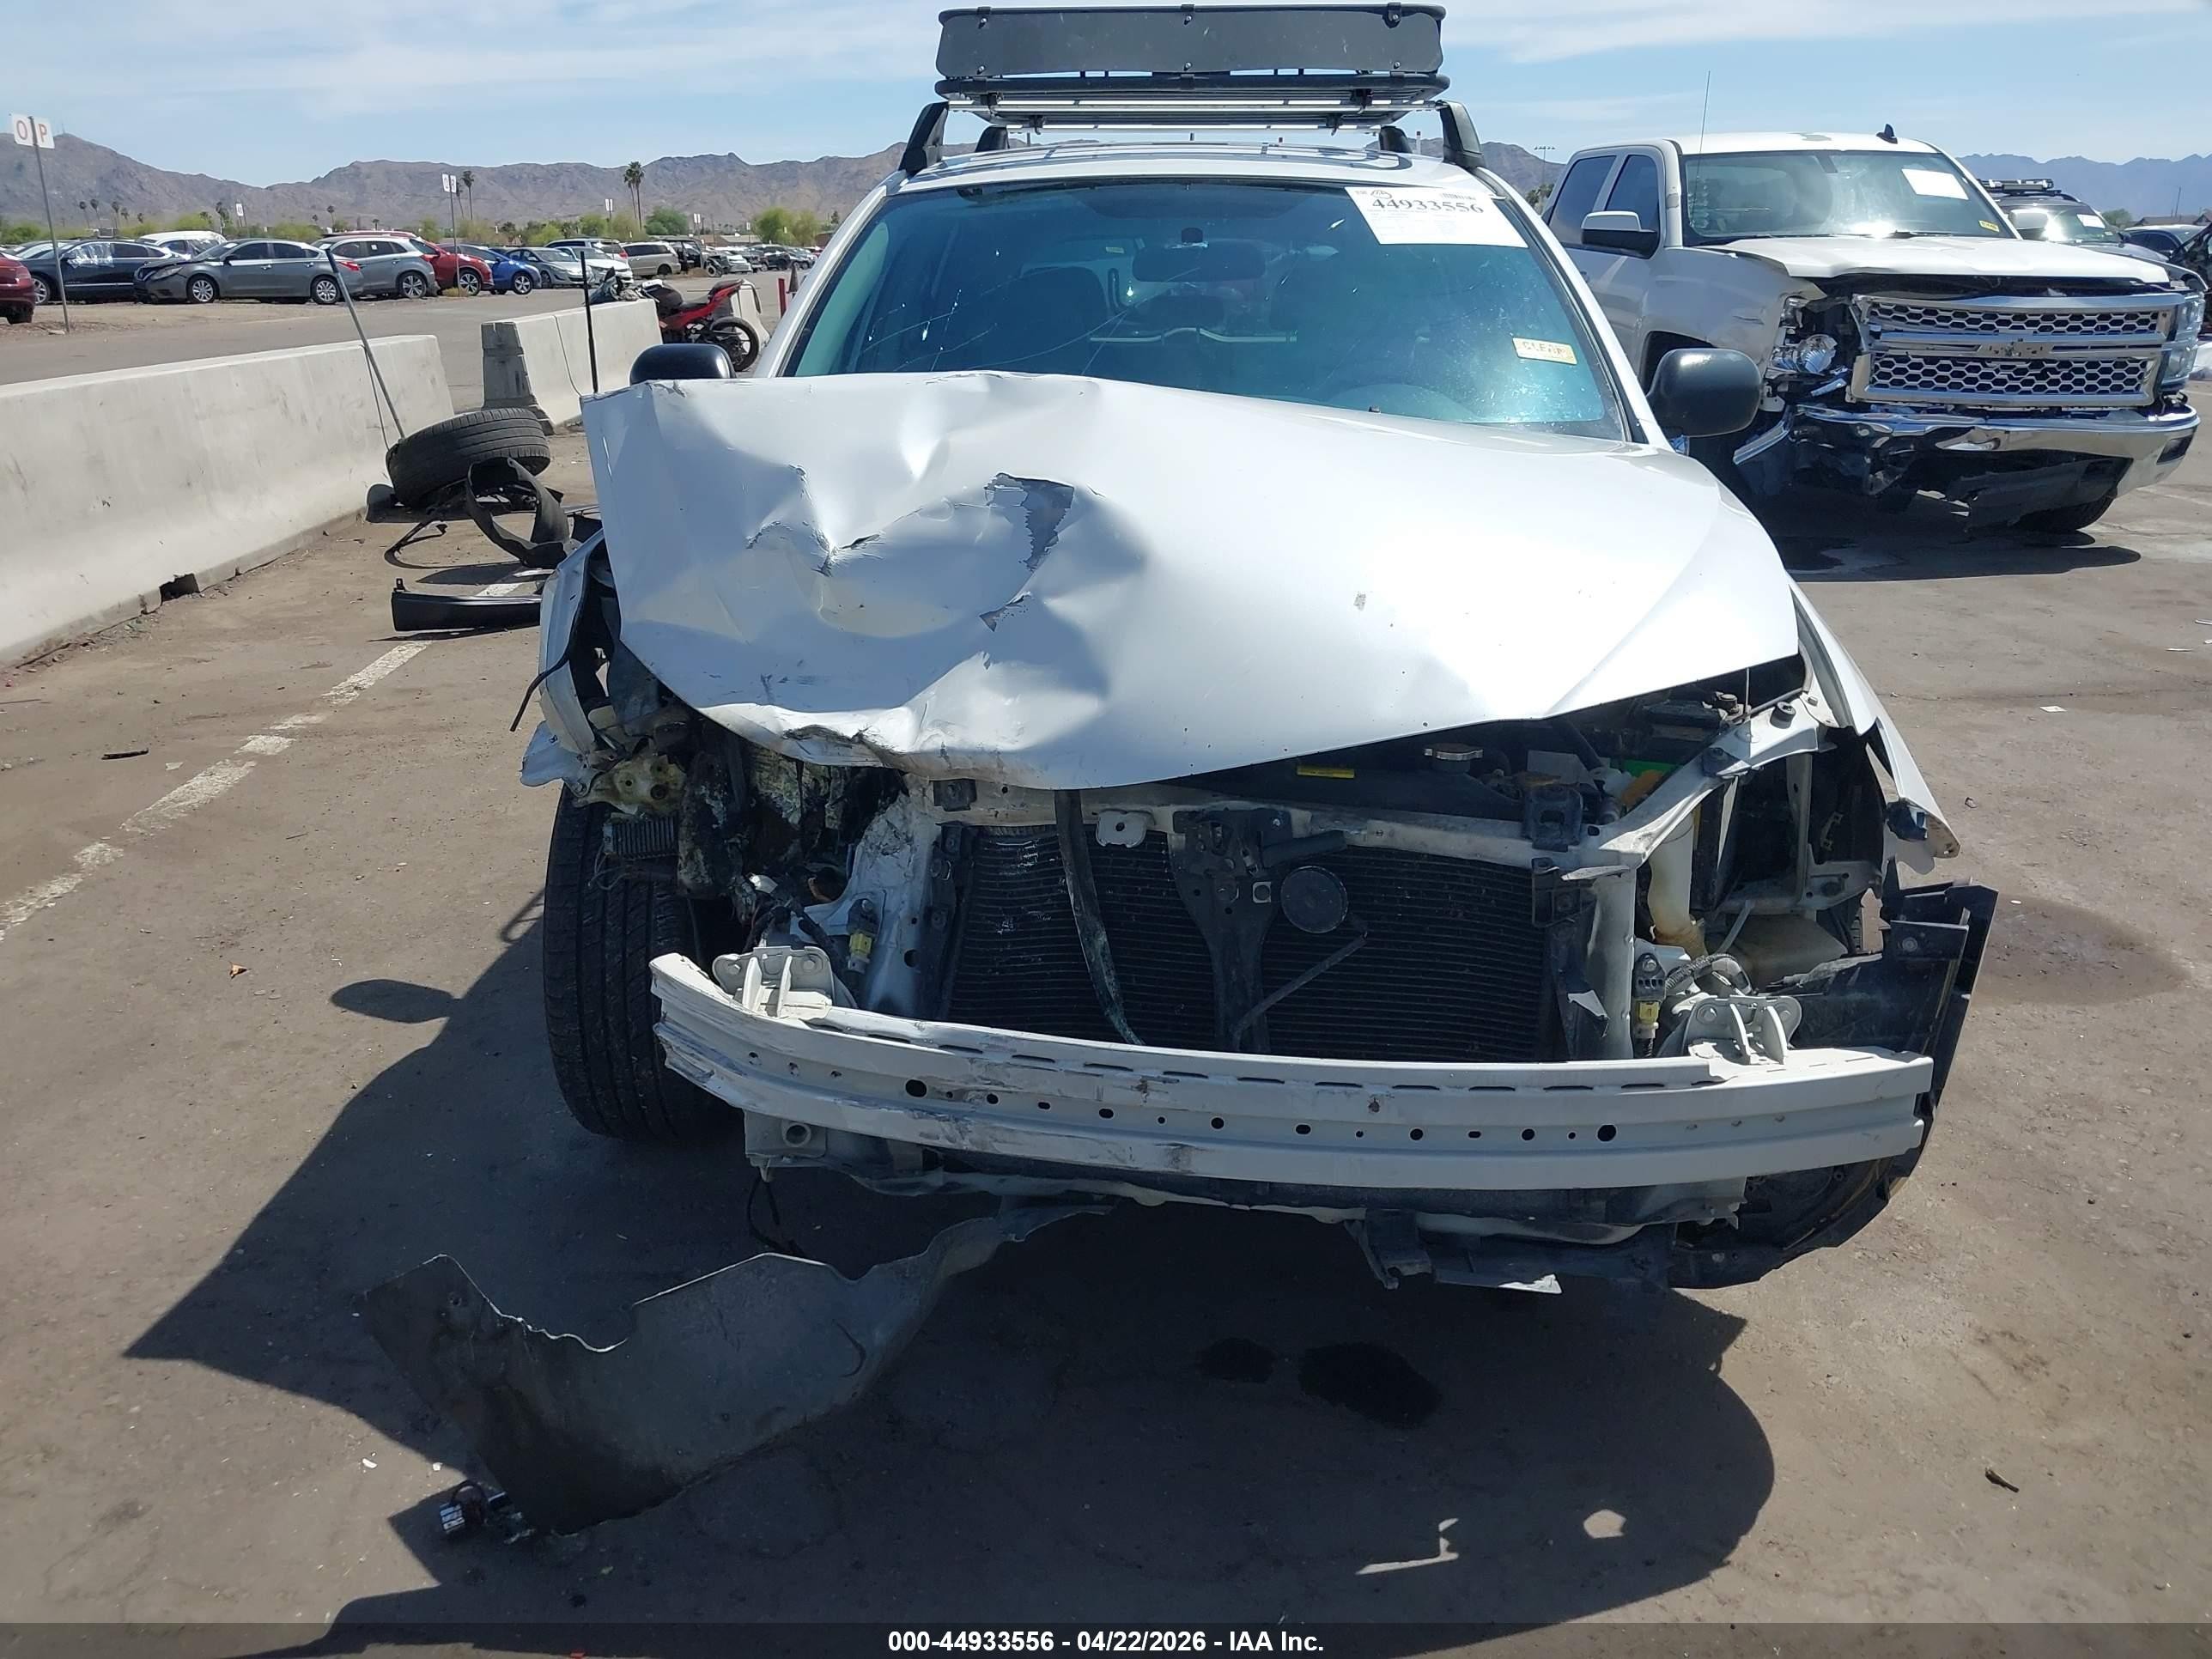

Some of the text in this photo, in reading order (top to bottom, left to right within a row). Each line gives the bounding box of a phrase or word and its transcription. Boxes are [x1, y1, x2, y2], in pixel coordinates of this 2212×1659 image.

[16, 120, 47, 143] O P
[1372, 198, 1484, 213] 44933556
